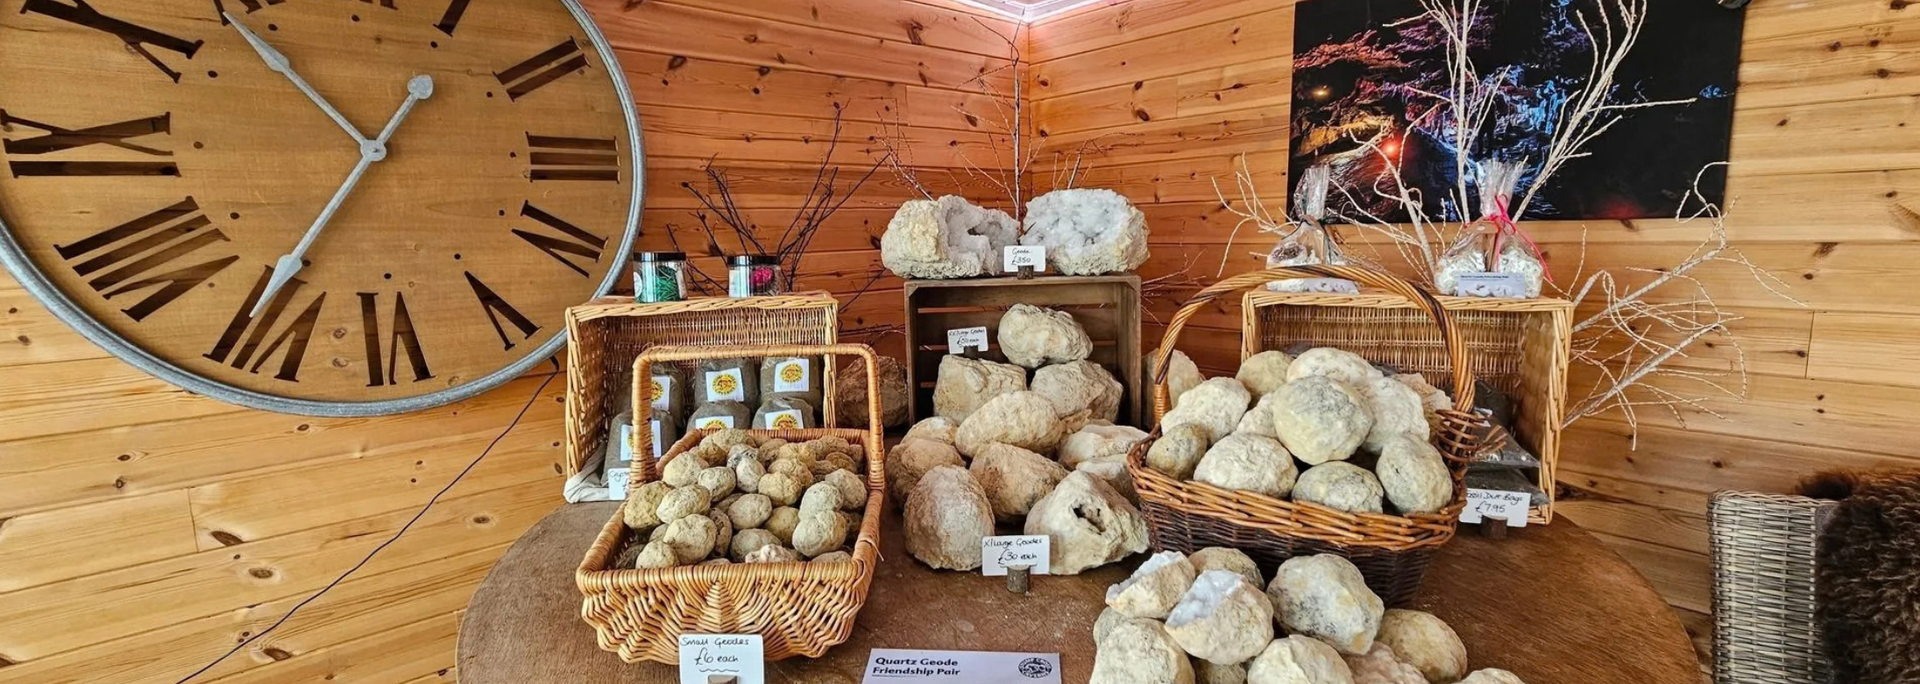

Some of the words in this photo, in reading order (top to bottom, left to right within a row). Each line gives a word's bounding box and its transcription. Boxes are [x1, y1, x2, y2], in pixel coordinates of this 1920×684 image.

[492, 36, 591, 102] II
[524, 130, 621, 184] III
[1011, 255, 1032, 266] £350
[464, 270, 542, 352] V
[997, 549, 1019, 565] £30
[1020, 552, 1038, 560] each
[680, 637, 709, 646] Small
[714, 637, 750, 649] Geodes
[694, 647, 714, 666] £6
[717, 654, 739, 662] each
[875, 657, 918, 666] Quartz
[920, 658, 959, 666] Geode
[872, 666, 935, 676] Friendship
[937, 667, 961, 676] Pair
